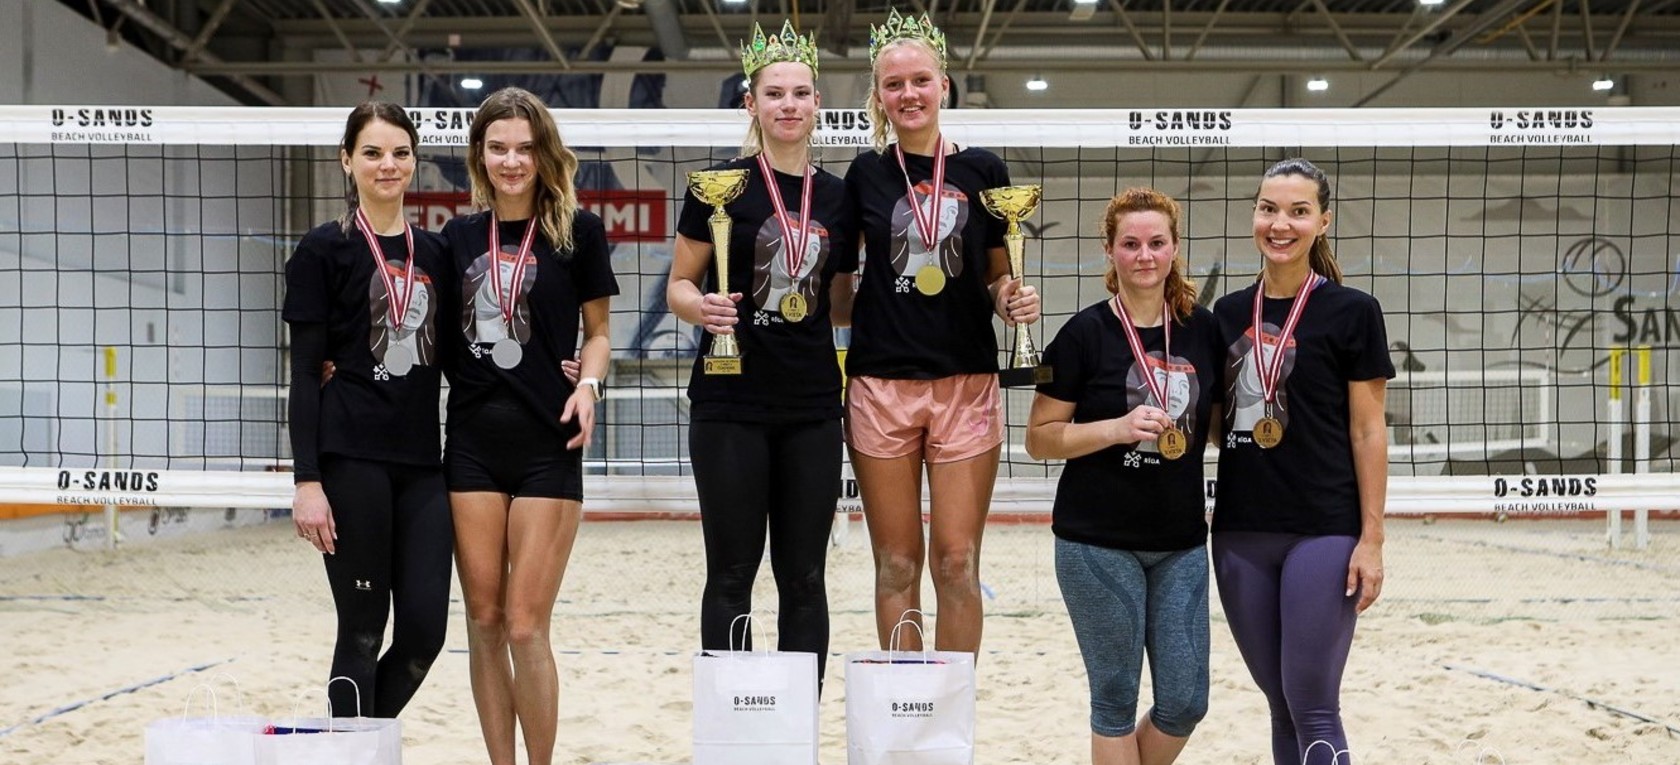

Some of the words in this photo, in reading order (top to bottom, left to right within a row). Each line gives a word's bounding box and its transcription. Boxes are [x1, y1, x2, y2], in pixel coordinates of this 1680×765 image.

[52, 109, 152, 127] O-SANDS
[1129, 112, 1231, 130] O-SANDS
[1491, 110, 1593, 129] O-SANDS
[51, 132, 85, 141] BEACH
[88, 132, 152, 141] VOLLEYBALL
[1128, 136, 1163, 145] BEACH
[1166, 136, 1231, 145] VOLLEYBALL
[1490, 134, 1524, 143] BEACH
[1527, 134, 1592, 143] VOLLEYBALL
[57, 470, 159, 491] O-SANDS
[1494, 478, 1597, 497] O-SANDS
[57, 495, 90, 504] BEACH
[93, 496, 156, 505] VOLLEYBALL
[1531, 502, 1596, 511] VOLLEYBALL
